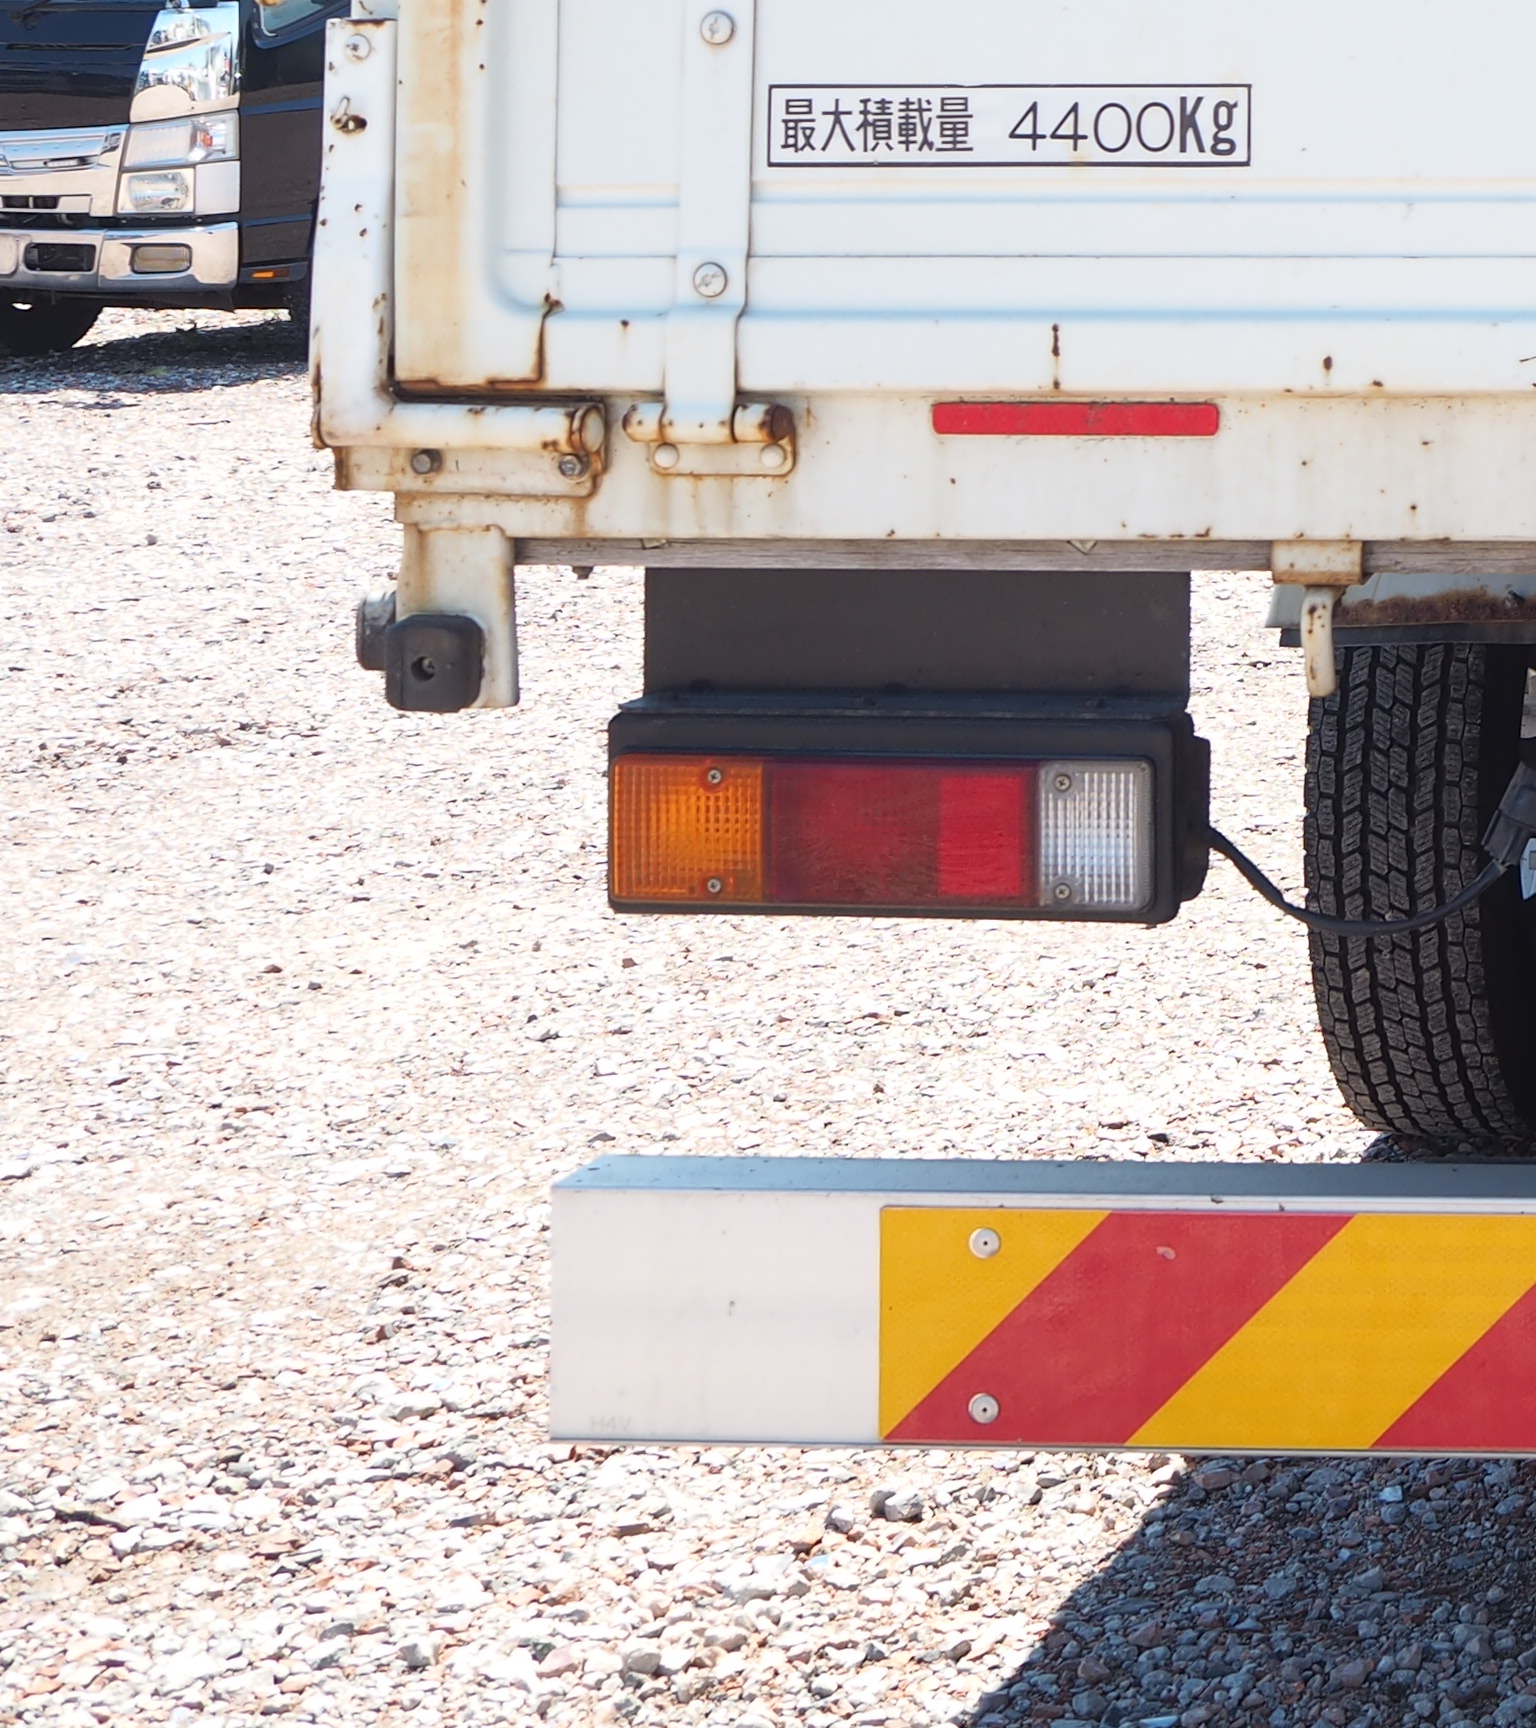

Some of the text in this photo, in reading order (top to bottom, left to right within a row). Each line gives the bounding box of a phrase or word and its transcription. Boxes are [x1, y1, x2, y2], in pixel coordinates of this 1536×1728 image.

[780, 96, 1238, 156] 最大積載量 4400Kg
